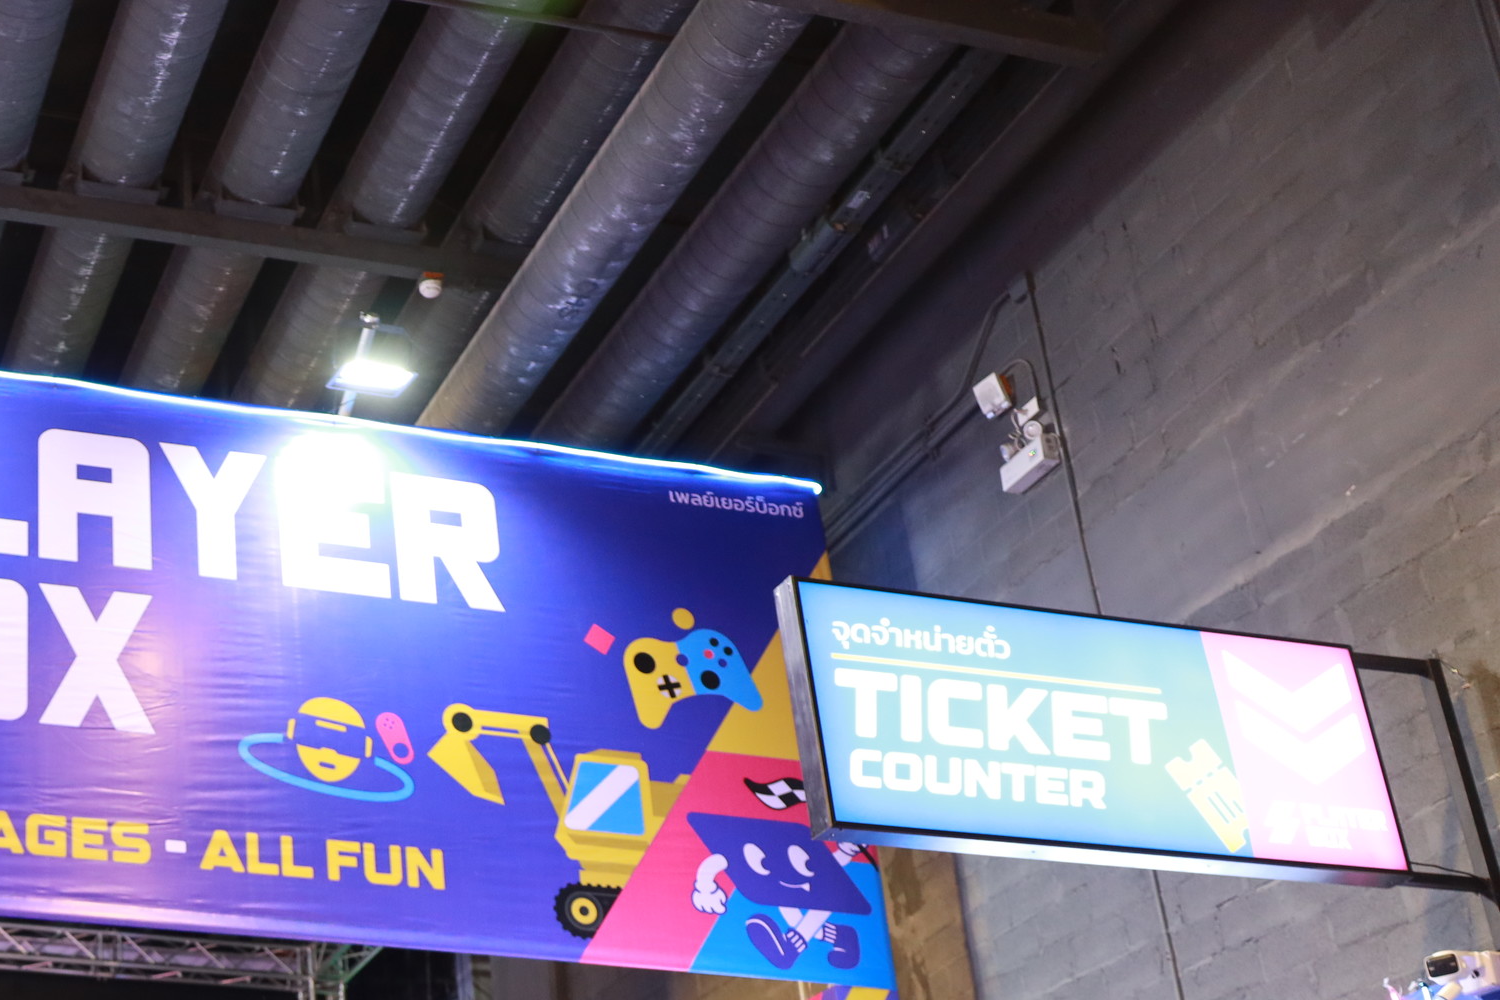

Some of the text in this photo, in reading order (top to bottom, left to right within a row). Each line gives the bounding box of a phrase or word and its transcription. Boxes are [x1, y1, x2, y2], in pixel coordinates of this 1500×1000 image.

[668, 490, 804, 519] เพลย์เยอร์บ็อกซ์
[831, 617, 1011, 659] จุดจำหน่ายตั๋ว
[834, 667, 1168, 765] TICKET
[850, 748, 1107, 810] COUNTER
[200, 830, 313, 880] ALL
[326, 839, 446, 890] FUN
